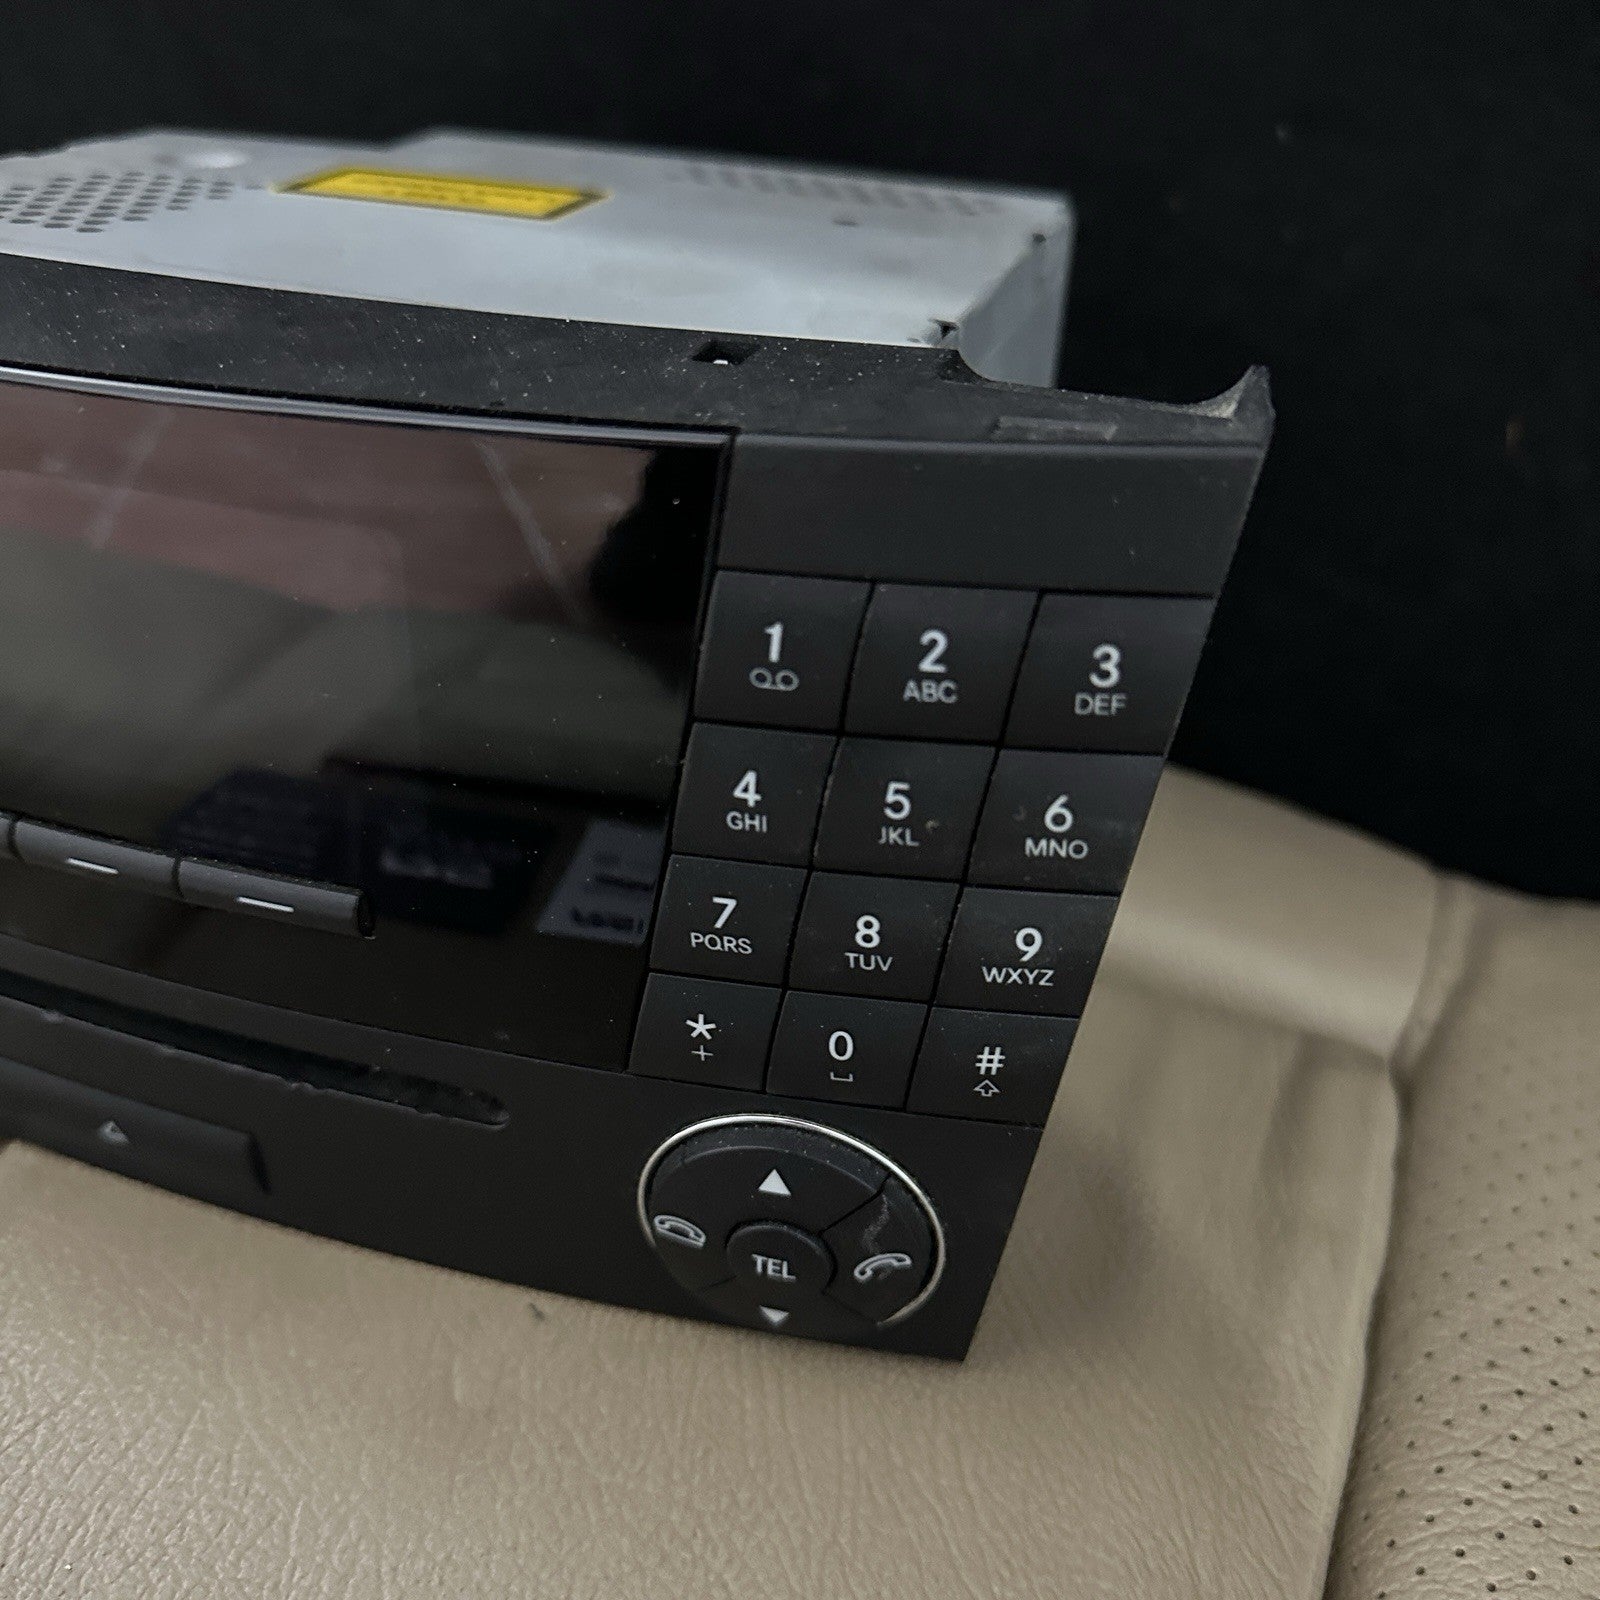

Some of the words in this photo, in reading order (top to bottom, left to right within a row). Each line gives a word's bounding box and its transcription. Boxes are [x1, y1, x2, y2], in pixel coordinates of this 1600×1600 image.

[765, 622, 784, 663] 1
[918, 629, 948, 673] 2
[1089, 644, 1121, 688] 3
[903, 679, 957, 704] ABC
[1074, 693, 1126, 716] DEF
[732, 770, 762, 808] 4
[883, 781, 912, 821] 5
[725, 810, 768, 833] GHI
[1044, 794, 1073, 833] 6
[878, 826, 919, 847] JKL
[1025, 837, 1089, 859] MNO
[712, 896, 737, 929] 7
[690, 931, 753, 955] PQRS
[854, 914, 881, 949] 8
[1015, 927, 1043, 962] 9
[844, 952, 893, 972] TUV
[981, 966, 1054, 987] WXYZ
[828, 1030, 854, 1061] 0
[751, 1253, 796, 1281] TEL
